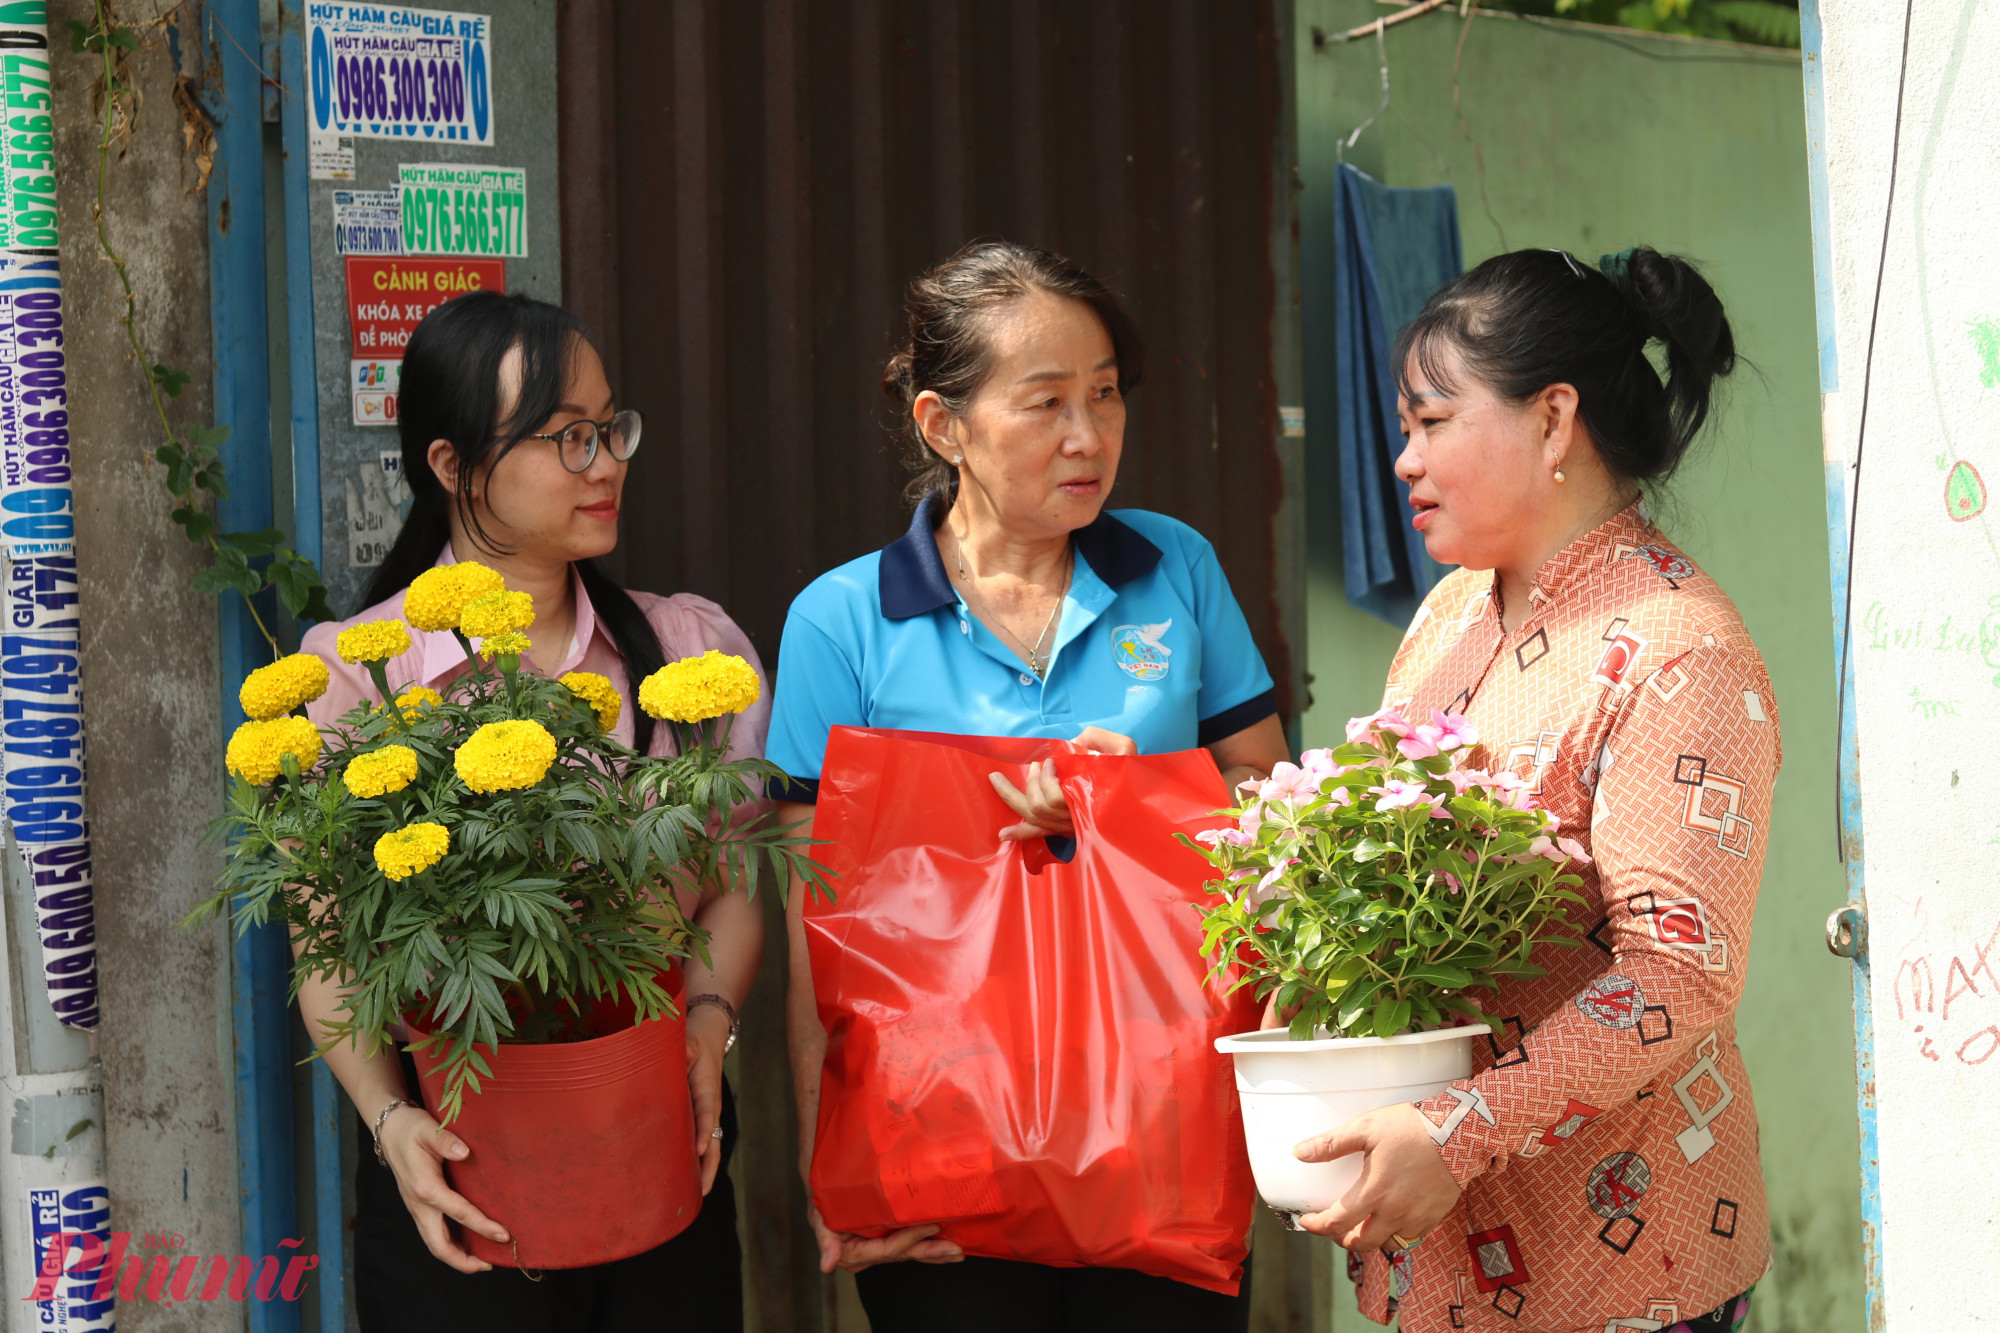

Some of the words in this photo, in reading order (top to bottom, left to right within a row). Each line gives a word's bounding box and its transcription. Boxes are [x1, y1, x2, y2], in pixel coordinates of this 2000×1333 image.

[310, 3, 343, 20] HÚT
[349, 6, 385, 24] HẦM
[390, 10, 421, 27] CẦU
[422, 15, 455, 36] GIÁ
[459, 17, 485, 39] RẺ
[334, 34, 360, 49] HÚT
[363, 36, 389, 50] HẦM
[391, 37, 416, 51] CẦU
[417, 40, 441, 57] GIÁ
[337, 55, 464, 123] 0986.300.300
[401, 167, 425, 182] HÚT
[428, 168, 455, 183] HẦM
[457, 169, 481, 184] CẦU
[482, 172, 503, 190] GIÁ
[403, 187, 524, 255] 0976.566.577
[373, 264, 429, 291] CẢNH
[434, 266, 482, 291] GIÁC
[358, 299, 401, 320] KHÓA
[405, 305, 424, 320] XE
[380, 328, 412, 346] PHÒ
[14, 292, 71, 484] 0986.300.300
[359, 363, 385, 386] FPT
[4, 450, 20, 486] HÚT
[8, 584, 34, 628] GIÁ
[2, 636, 83, 842] 0919.487.497
[31, 1191, 59, 1225] RẺ
[36, 1233, 61, 1276] GIÁ
